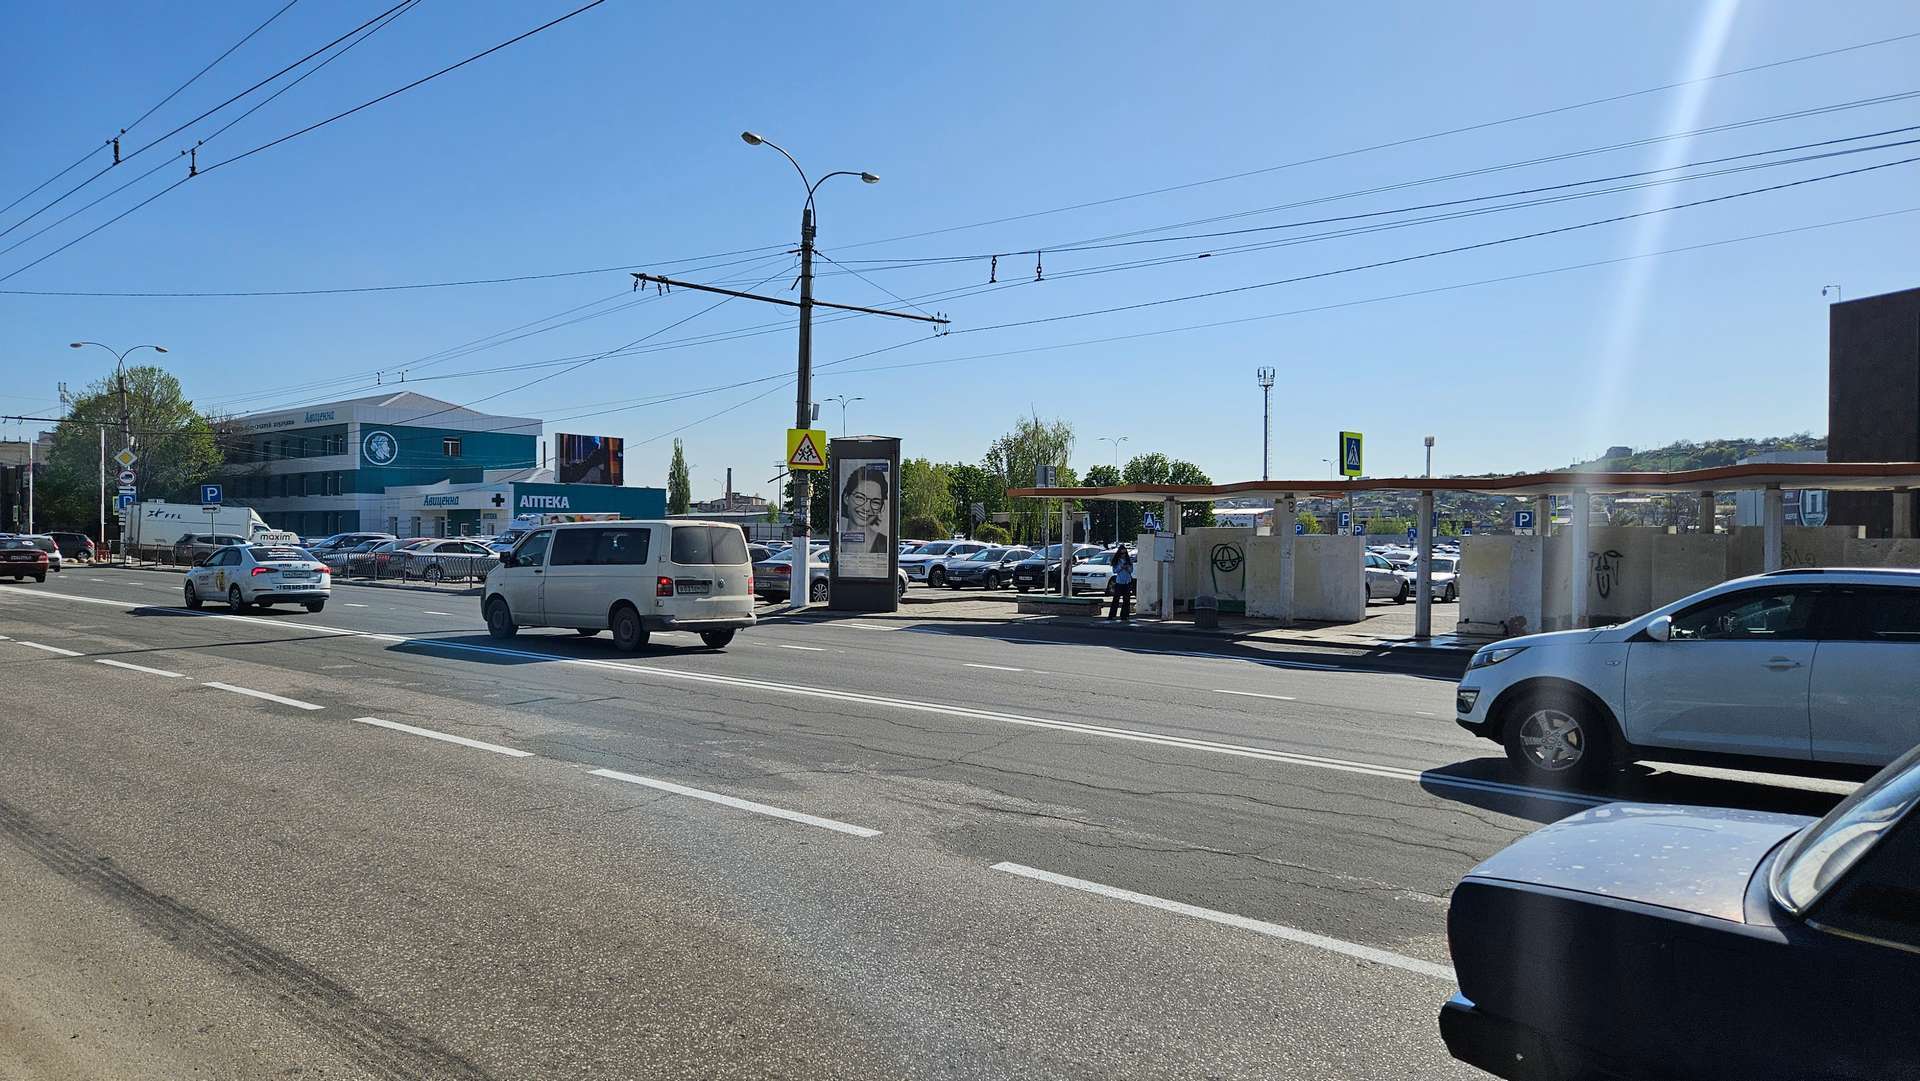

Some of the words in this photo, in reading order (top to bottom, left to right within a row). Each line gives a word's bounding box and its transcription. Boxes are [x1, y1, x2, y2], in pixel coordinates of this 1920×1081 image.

[207, 487, 218, 501] P
[424, 495, 459, 508] Авиценна
[520, 495, 570, 508] АПТЕКА
[1519, 512, 1530, 526] P
[260, 533, 291, 542] maxim
